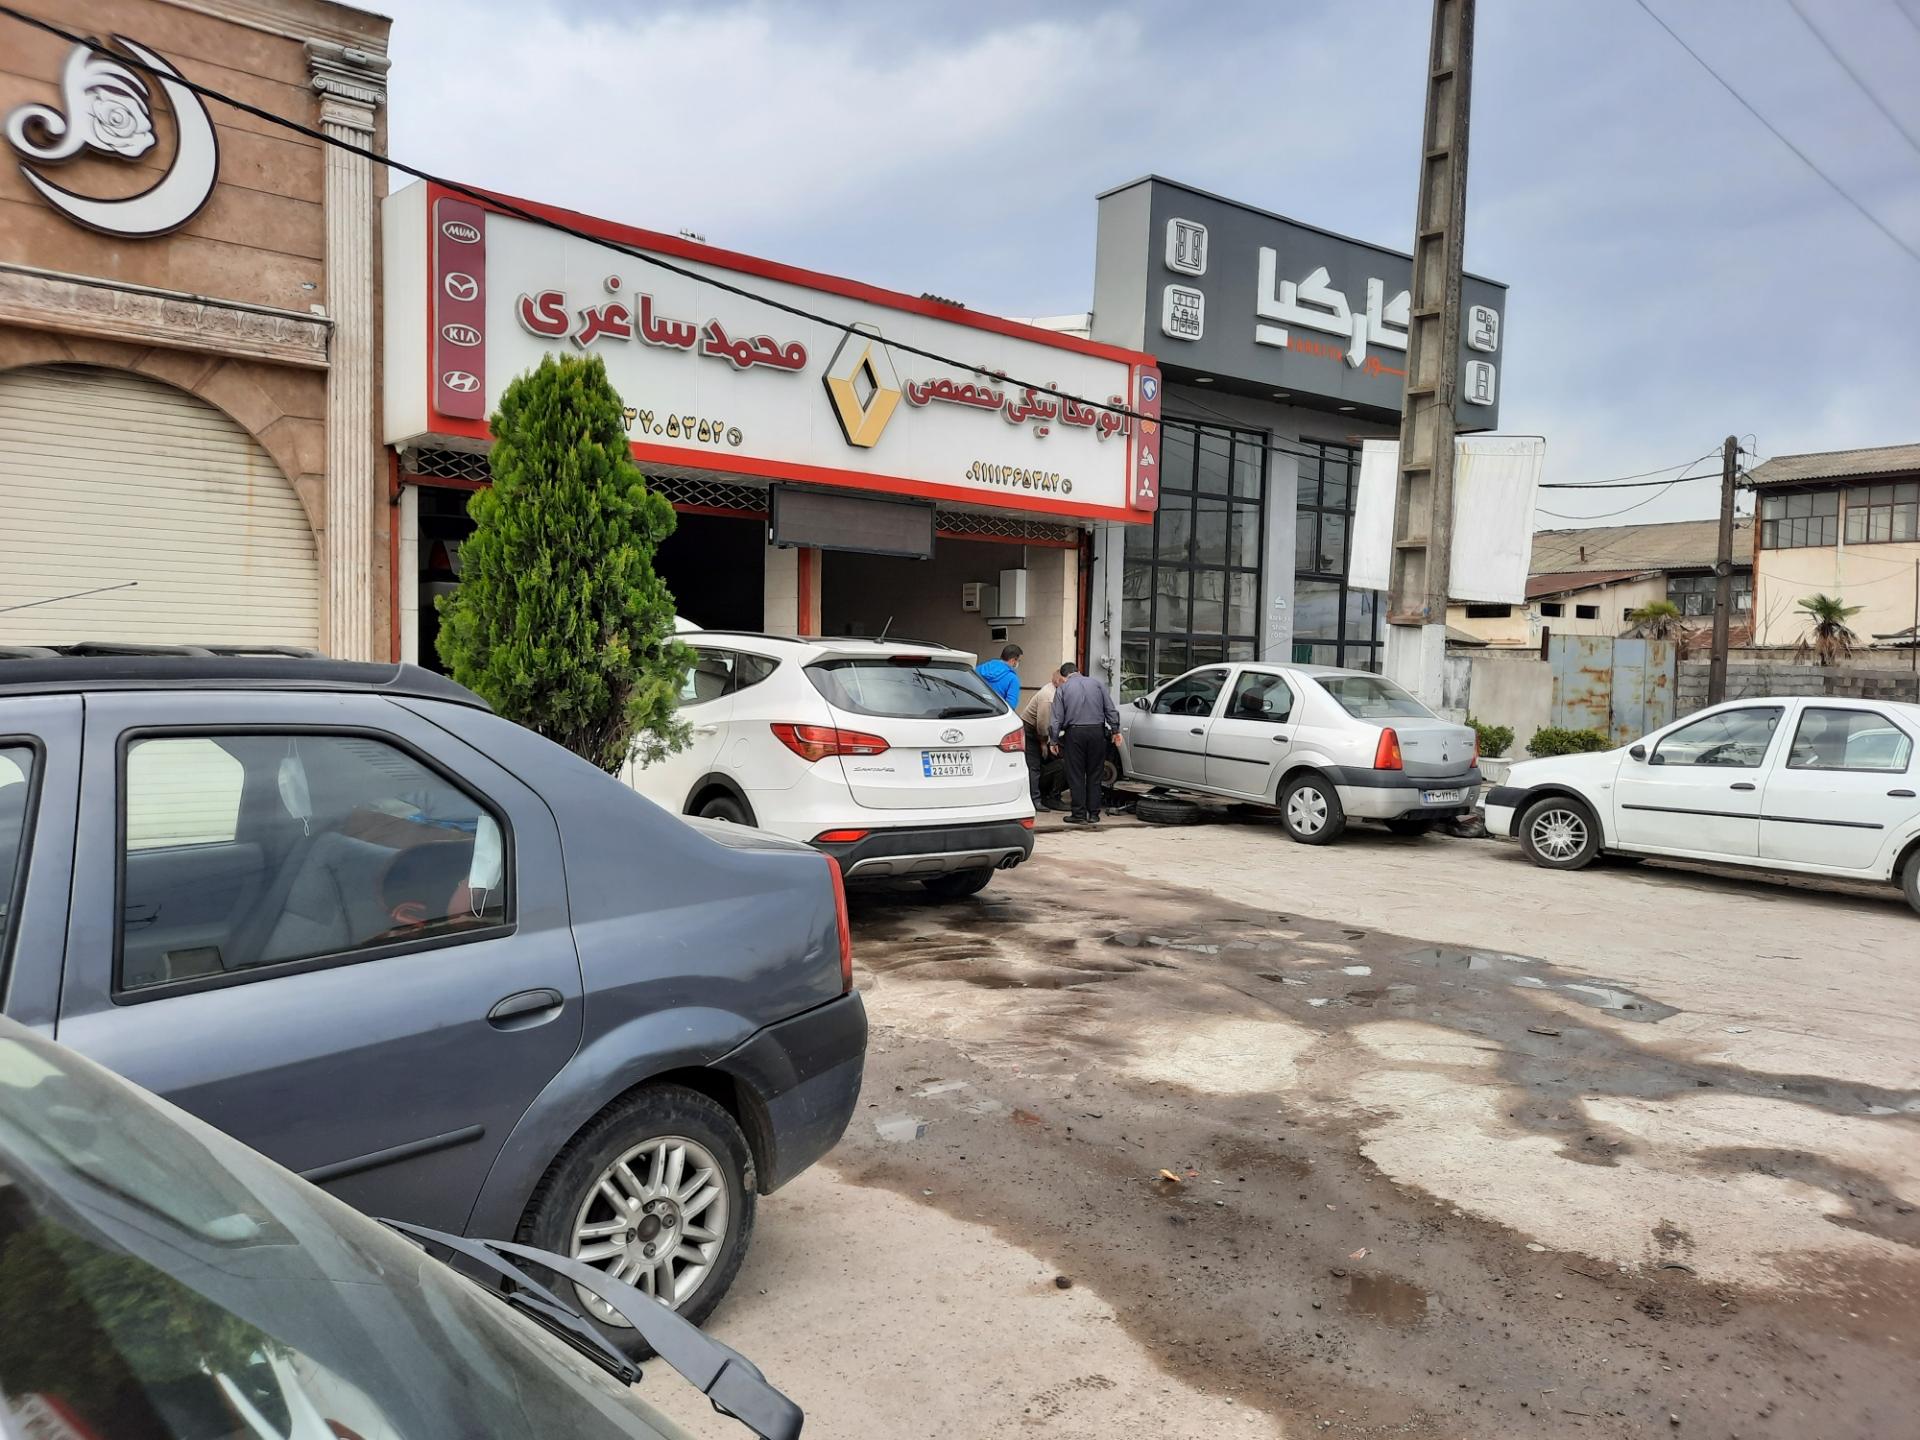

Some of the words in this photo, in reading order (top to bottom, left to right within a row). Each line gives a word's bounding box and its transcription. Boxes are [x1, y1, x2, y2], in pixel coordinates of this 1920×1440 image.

[448, 326, 477, 344] KIA
[516, 274, 699, 350] ساغری
[698, 317, 809, 371] محمد
[903, 364, 1006, 411] تخصصی
[932, 766, 959, 775] 22497
